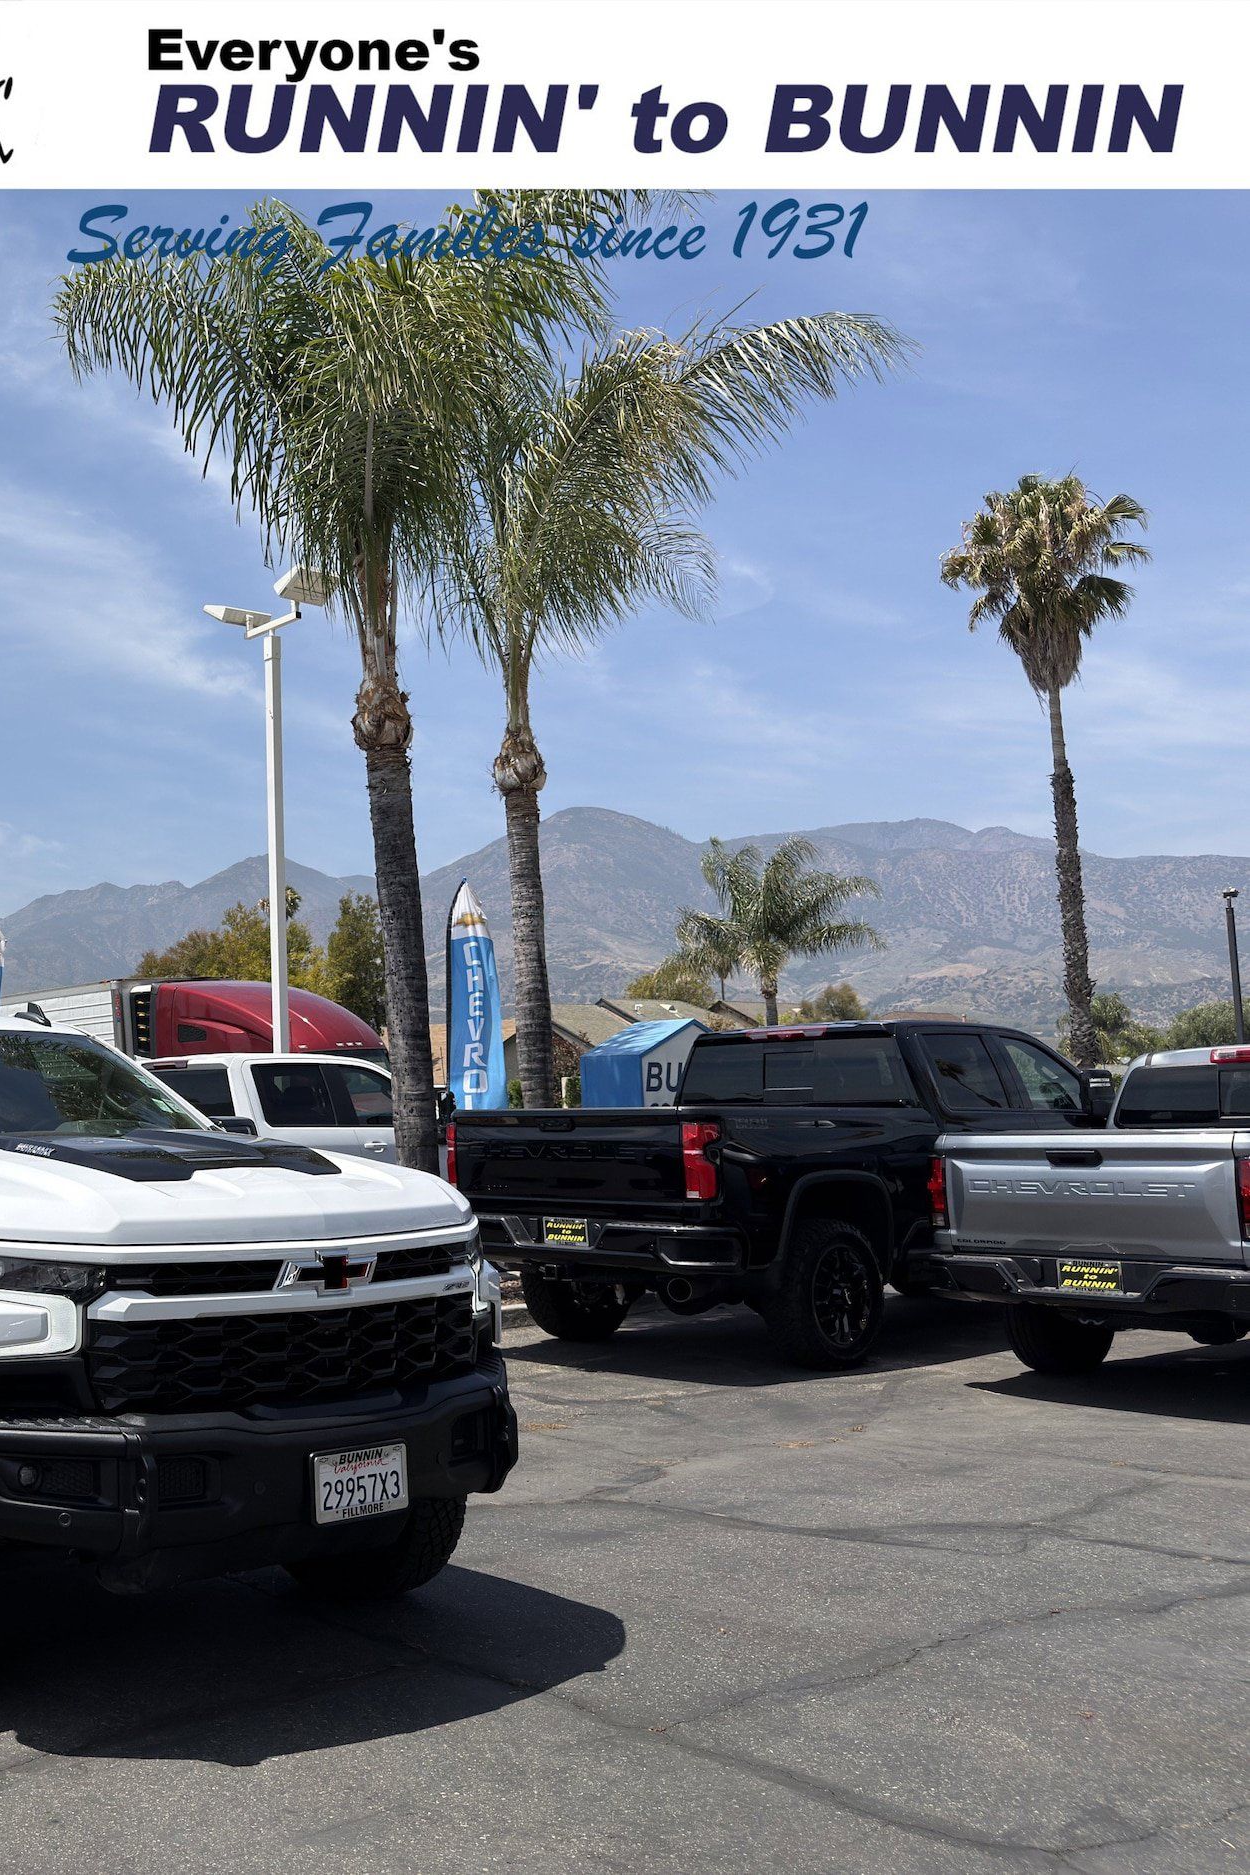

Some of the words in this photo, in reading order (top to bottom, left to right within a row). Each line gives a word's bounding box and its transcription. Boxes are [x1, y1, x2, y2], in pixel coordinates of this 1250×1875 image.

[968, 1178, 1196, 1198] CHEVROLET
[1061, 1265, 1119, 1275] RUNNIN'
[1062, 1279, 1117, 1290] BUNNIN
[339, 1448, 384, 1465] BUNNIN
[323, 1470, 400, 1511] 29957X3
[342, 1502, 384, 1518] FILLMORE
